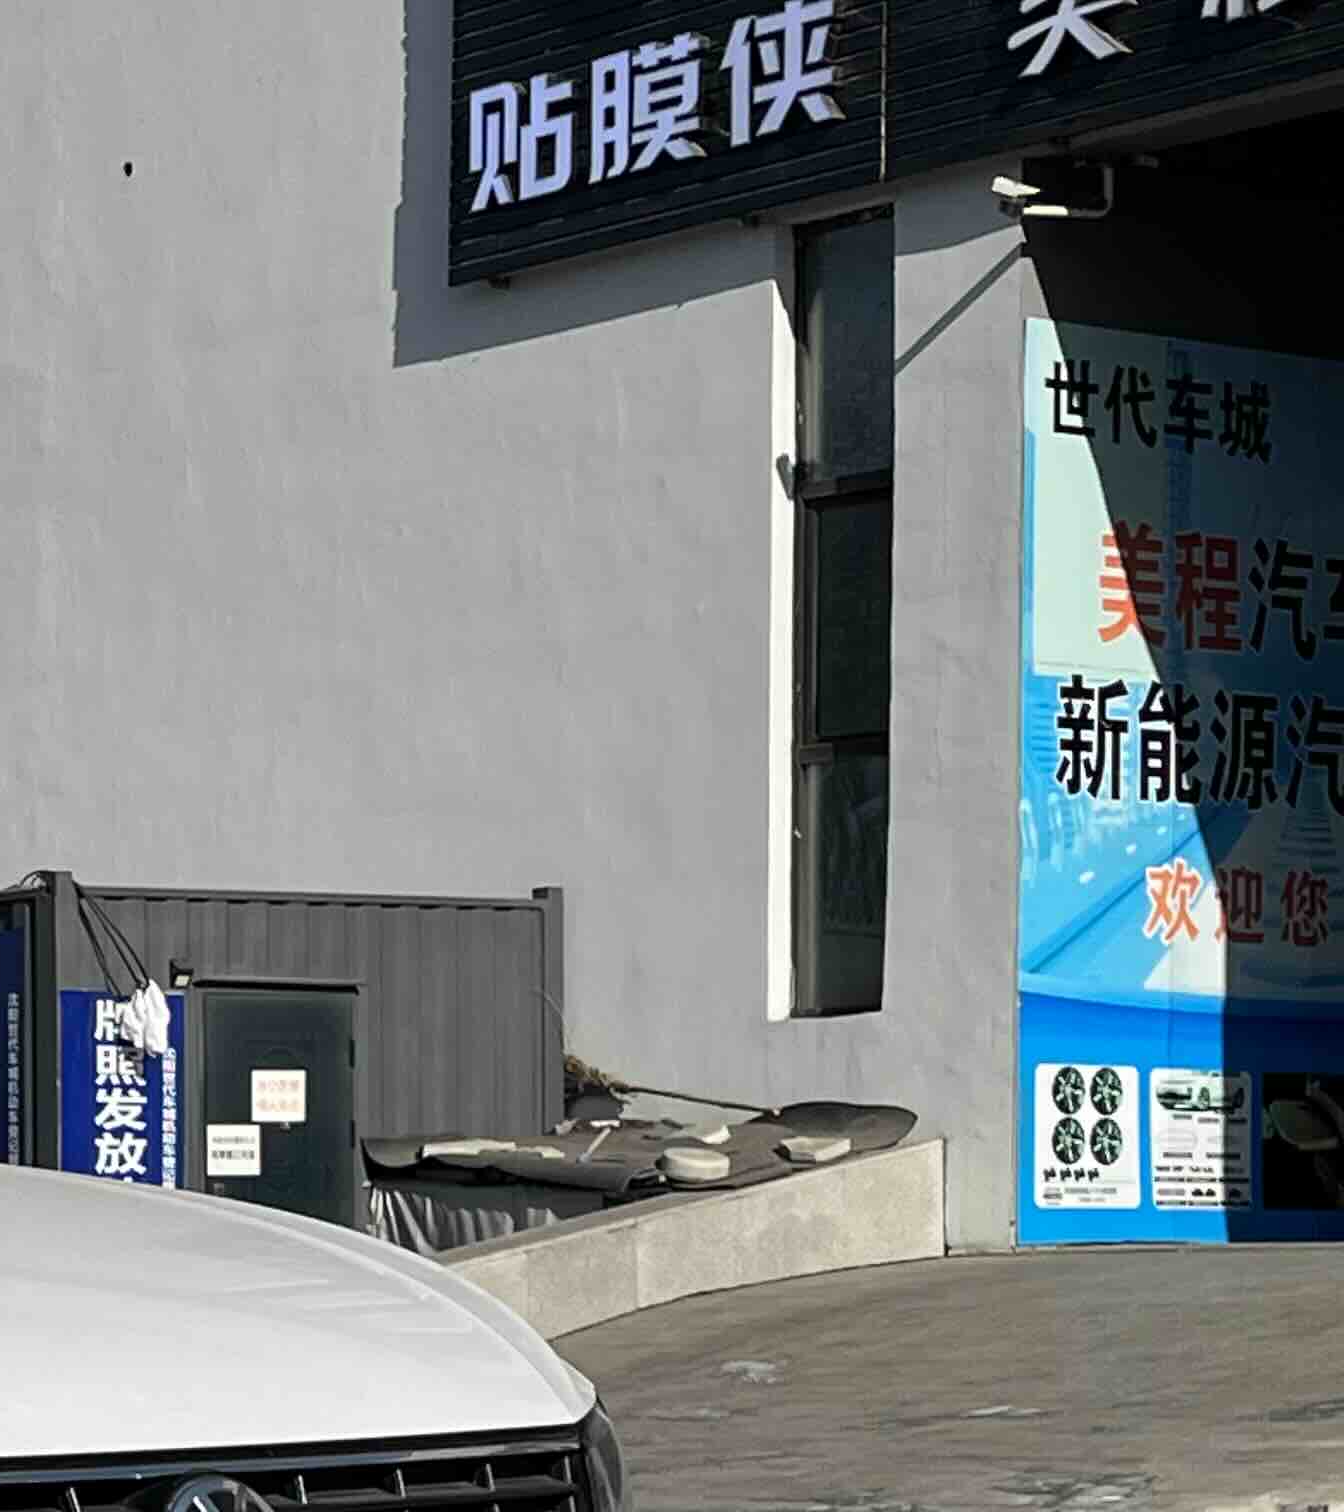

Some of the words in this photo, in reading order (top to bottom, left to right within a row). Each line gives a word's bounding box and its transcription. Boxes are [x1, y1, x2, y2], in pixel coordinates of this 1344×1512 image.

[469, 0, 846, 212] 贴膜侠
[1045, 360, 1272, 463] 世代车城
[1055, 674, 1344, 817] 新能源汽
[1146, 861, 1329, 945] 欢迎您
[94, 1000, 148, 1183] 牌照发放
